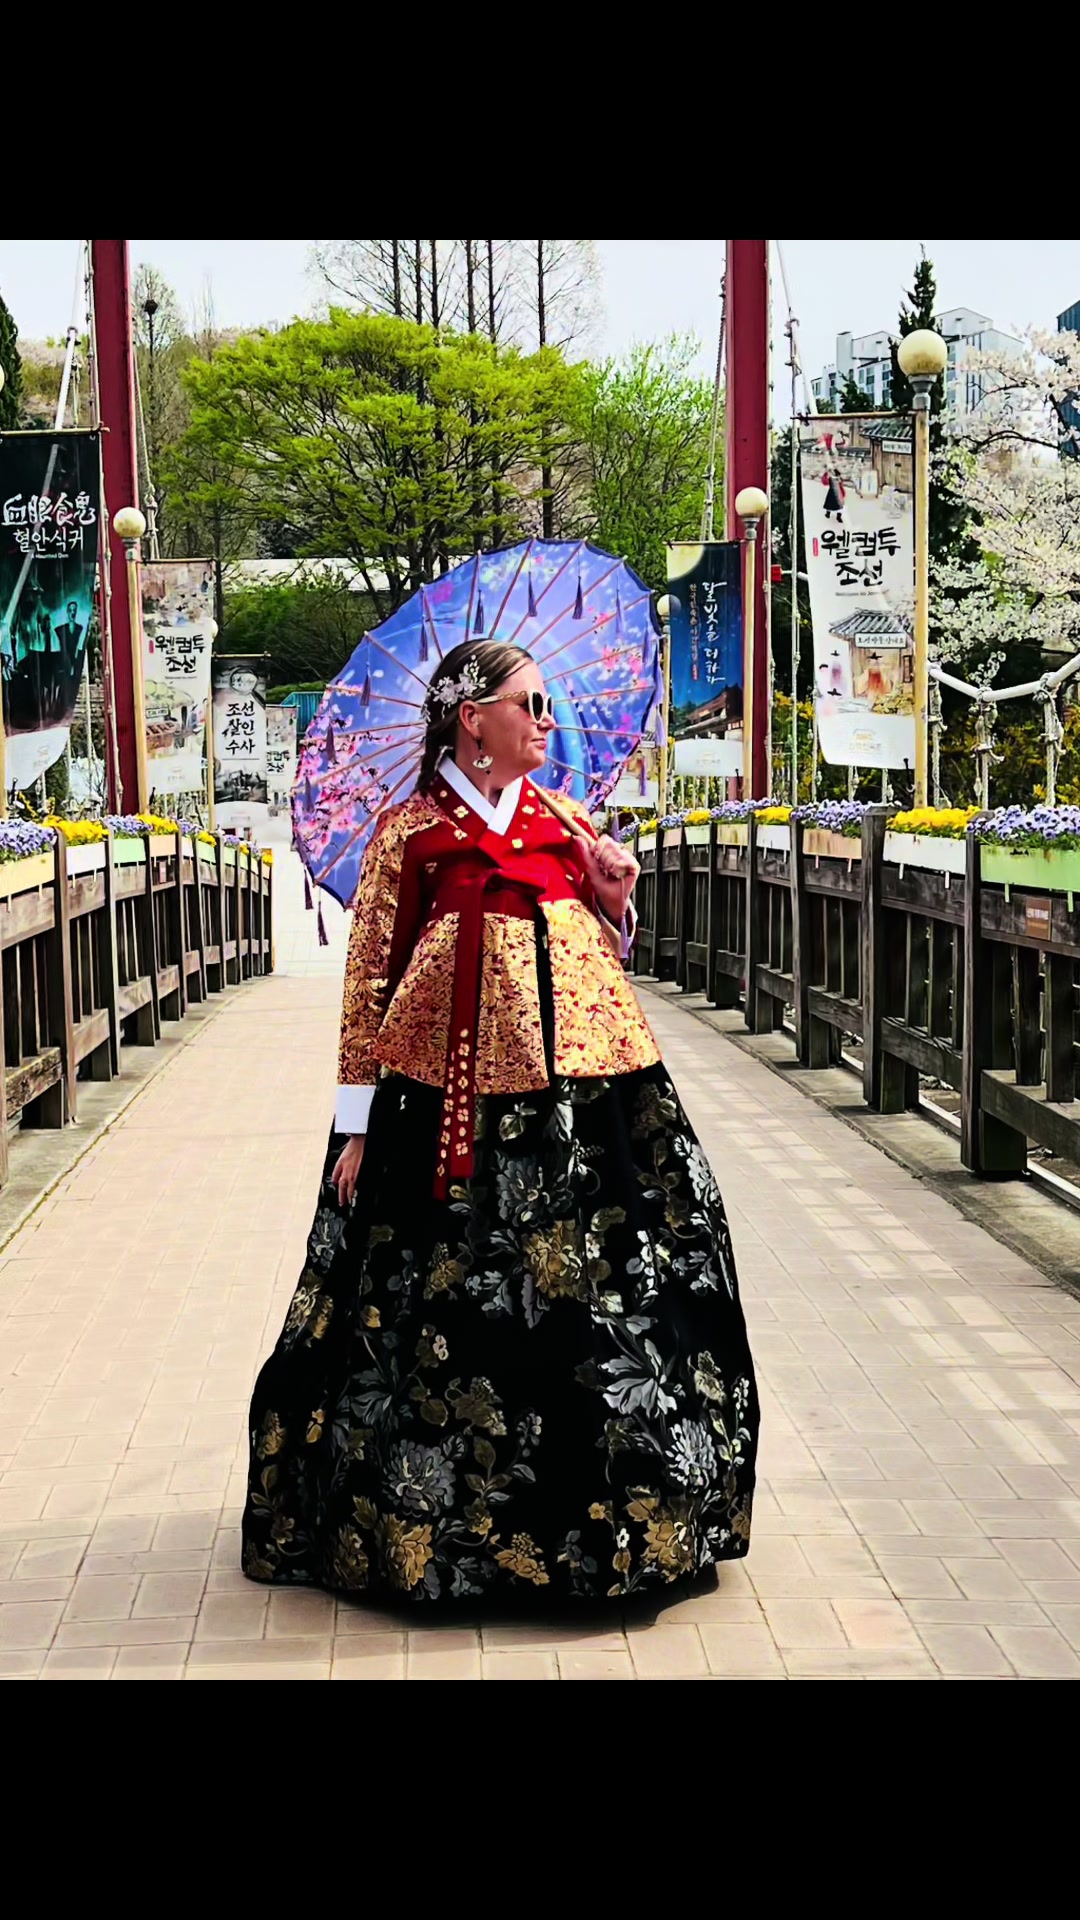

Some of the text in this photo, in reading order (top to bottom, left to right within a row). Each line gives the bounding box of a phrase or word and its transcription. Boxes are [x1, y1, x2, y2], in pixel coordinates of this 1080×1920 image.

[2, 491, 96, 526] 血眼食鬼
[820, 527, 901, 560] 웰컴투
[835, 558, 883, 587] 조선
[702, 582, 727, 642] 달빛을
[155, 634, 206, 655] 웰컴투
[165, 655, 196, 674] 조선
[226, 700, 255, 717] 조선
[222, 718, 255, 737] 살인
[225, 738, 256, 755] 수사
